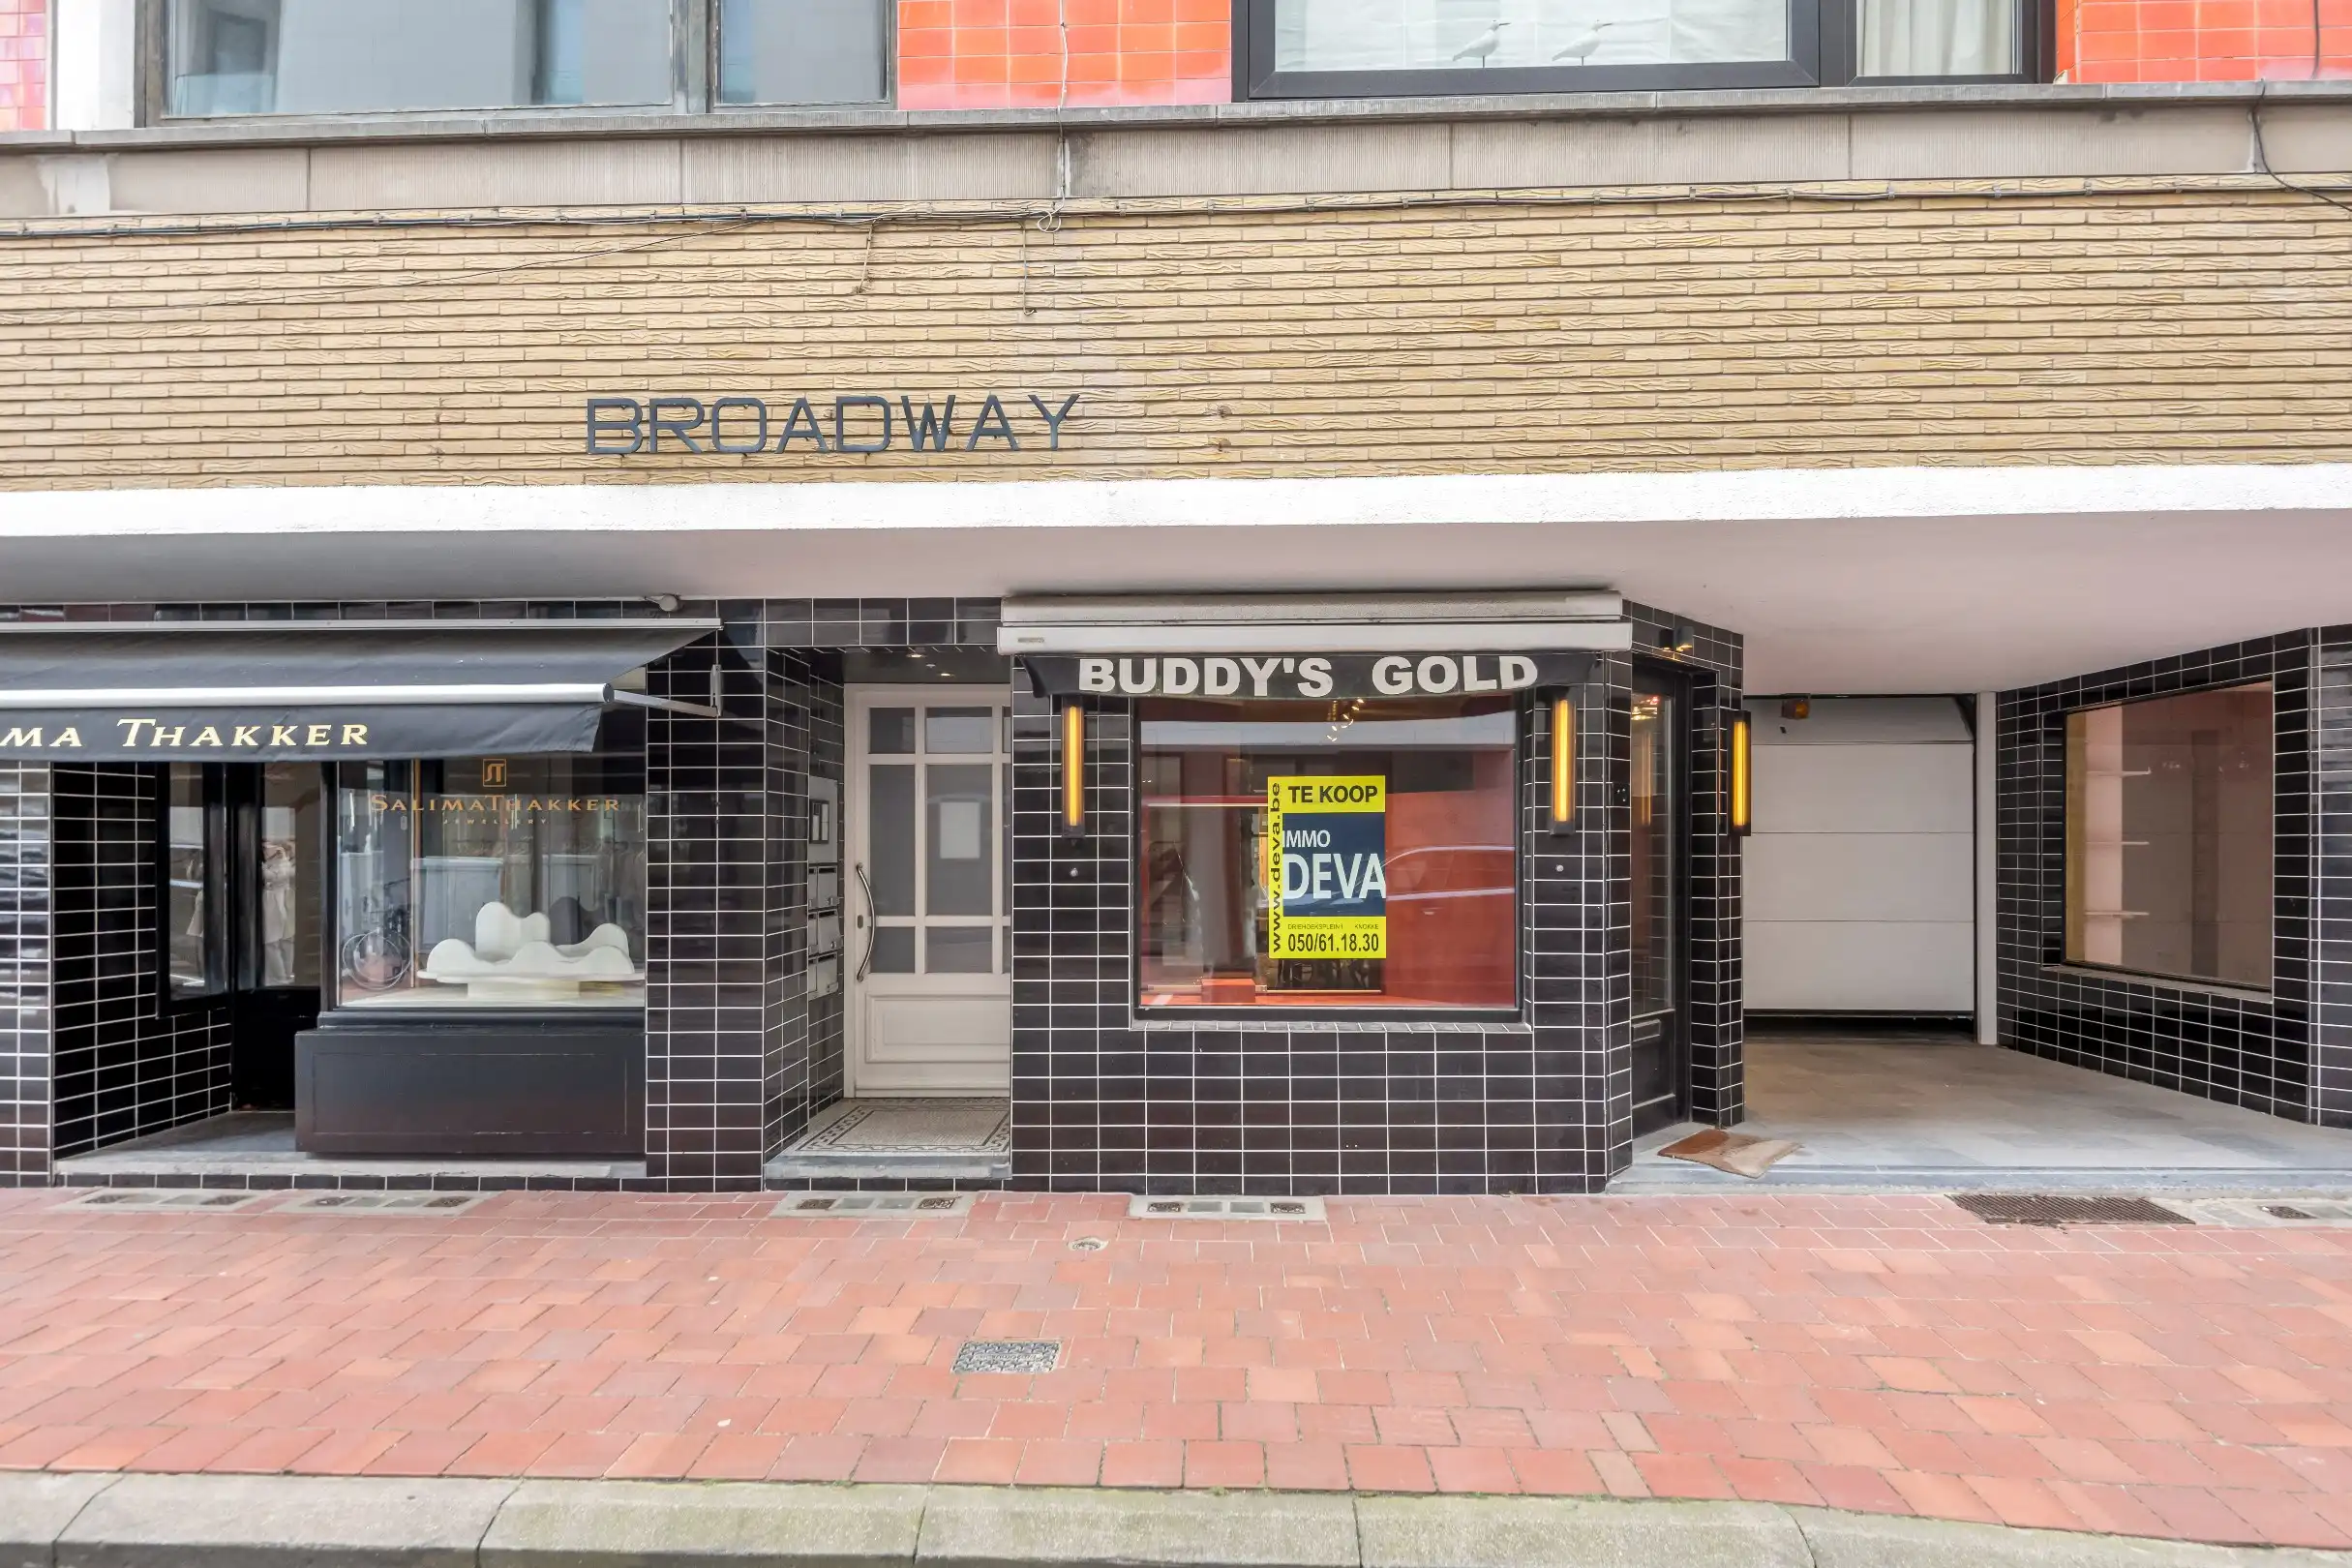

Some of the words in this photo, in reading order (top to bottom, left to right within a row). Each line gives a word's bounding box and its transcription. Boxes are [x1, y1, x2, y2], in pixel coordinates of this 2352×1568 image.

[587, 393, 1081, 454] BROADWAY
[1078, 657, 1333, 698] BUDDY'S
[1371, 655, 1538, 695] GOLD
[117, 718, 368, 747] THAKKER
[1288, 786, 1312, 803] TE
[1319, 785, 1378, 803] KOOP
[1282, 829, 1331, 848] IMMO
[1270, 782, 1282, 952] www.deva.be
[1282, 853, 1386, 899] DEVA
[1287, 933, 1379, 952] 050/61.18.30
